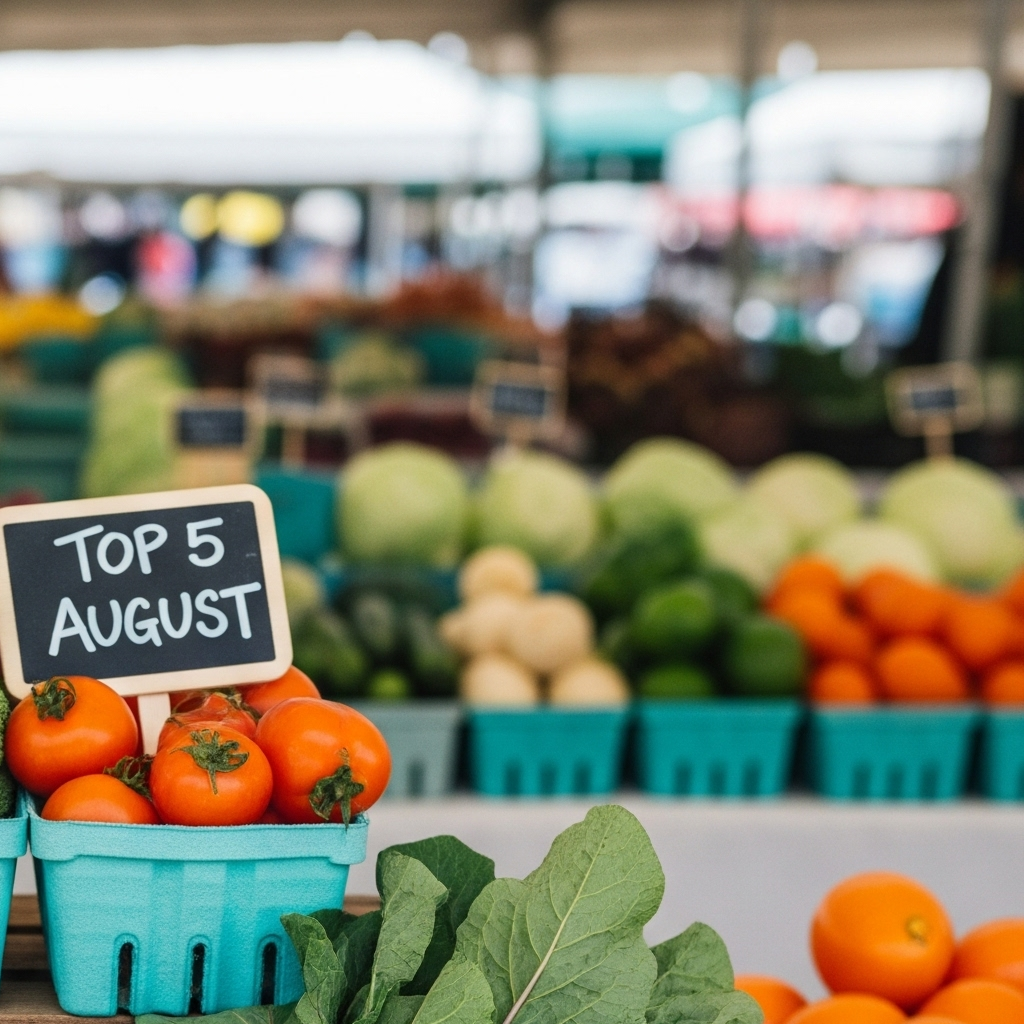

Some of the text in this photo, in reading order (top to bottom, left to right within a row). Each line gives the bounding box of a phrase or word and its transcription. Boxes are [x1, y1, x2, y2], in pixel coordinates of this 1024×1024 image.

[54, 517, 225, 583] TOP 5
[49, 582, 262, 657] AUGUST
